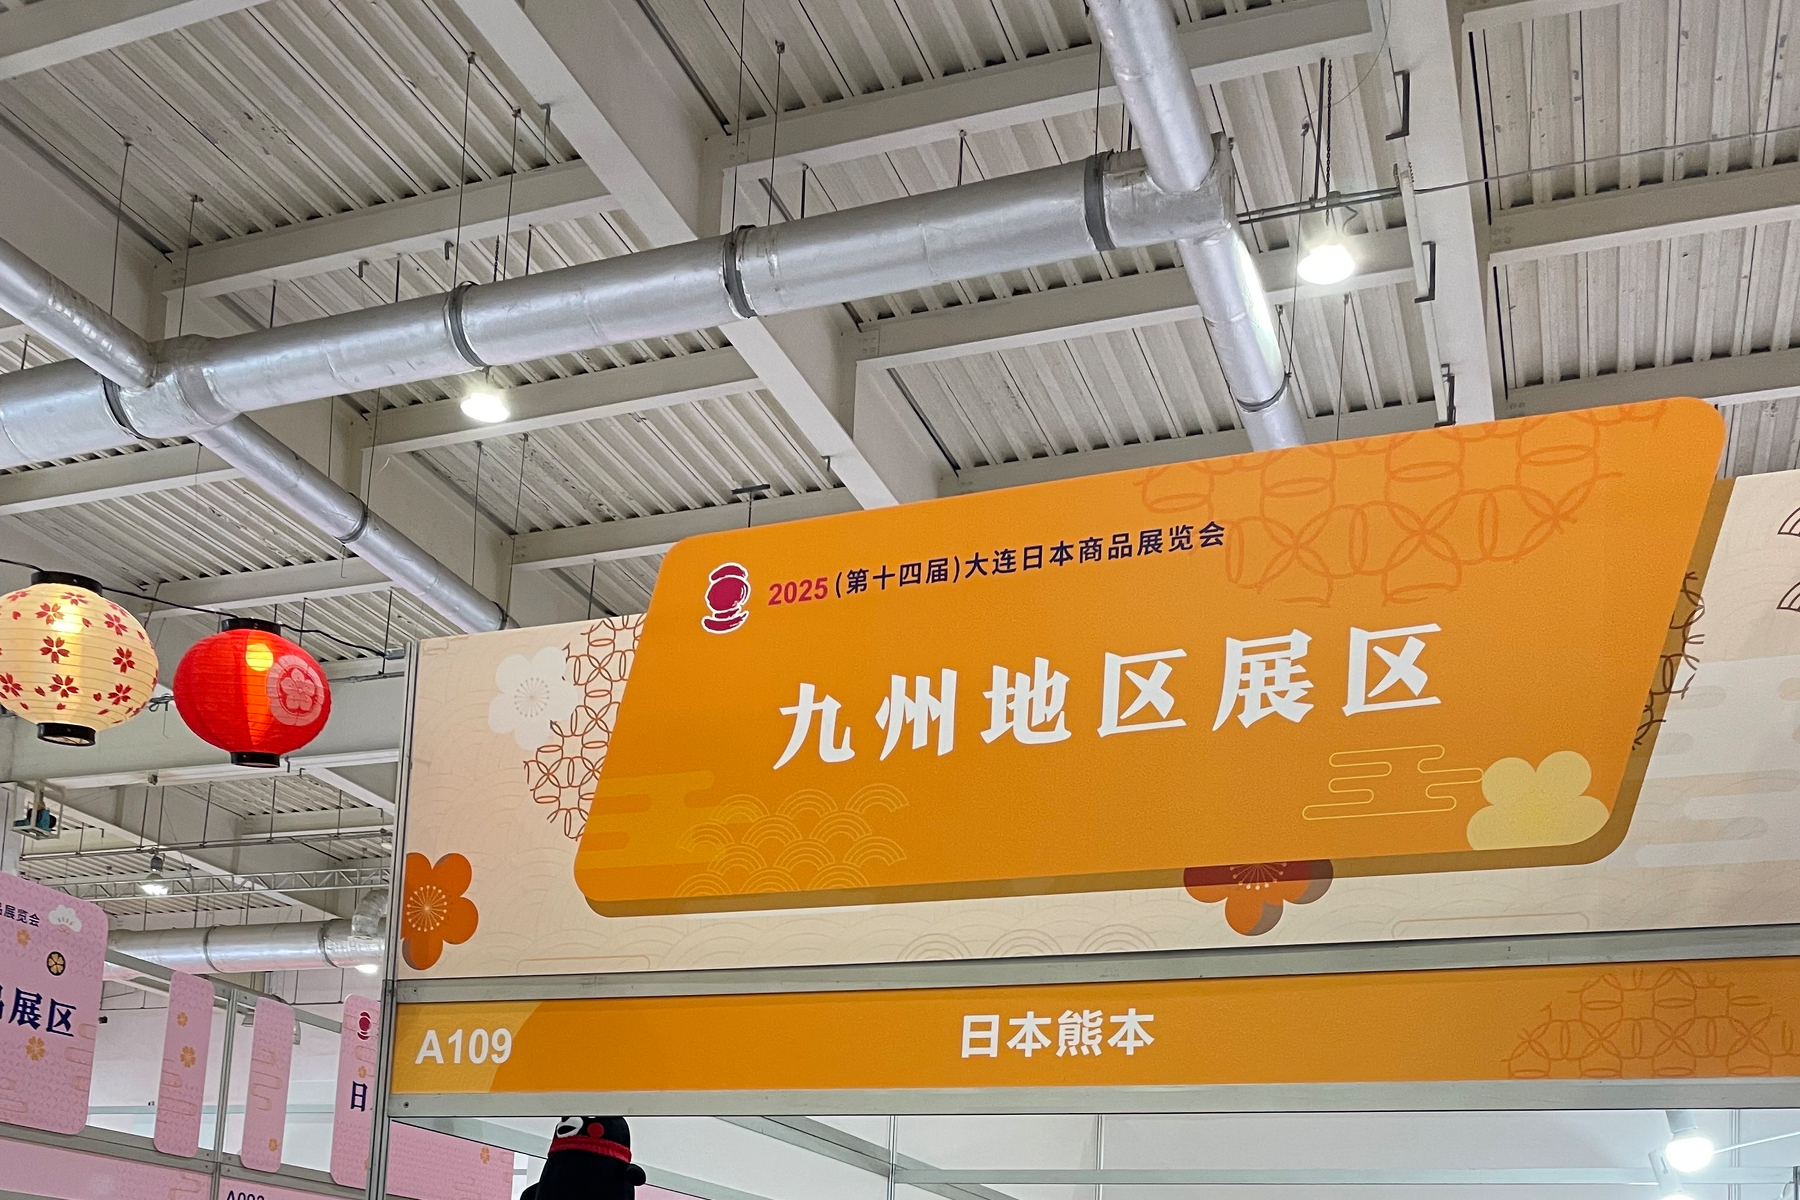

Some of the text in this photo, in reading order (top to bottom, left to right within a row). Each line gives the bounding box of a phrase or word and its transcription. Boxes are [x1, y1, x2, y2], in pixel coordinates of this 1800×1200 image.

[773, 622, 1443, 770] 九州地区展区
[0, 902, 41, 928] 展览会
[0, 984, 77, 1038] 展区
[960, 1008, 1155, 1059] 日本熊本
[415, 1028, 512, 1065] A109
